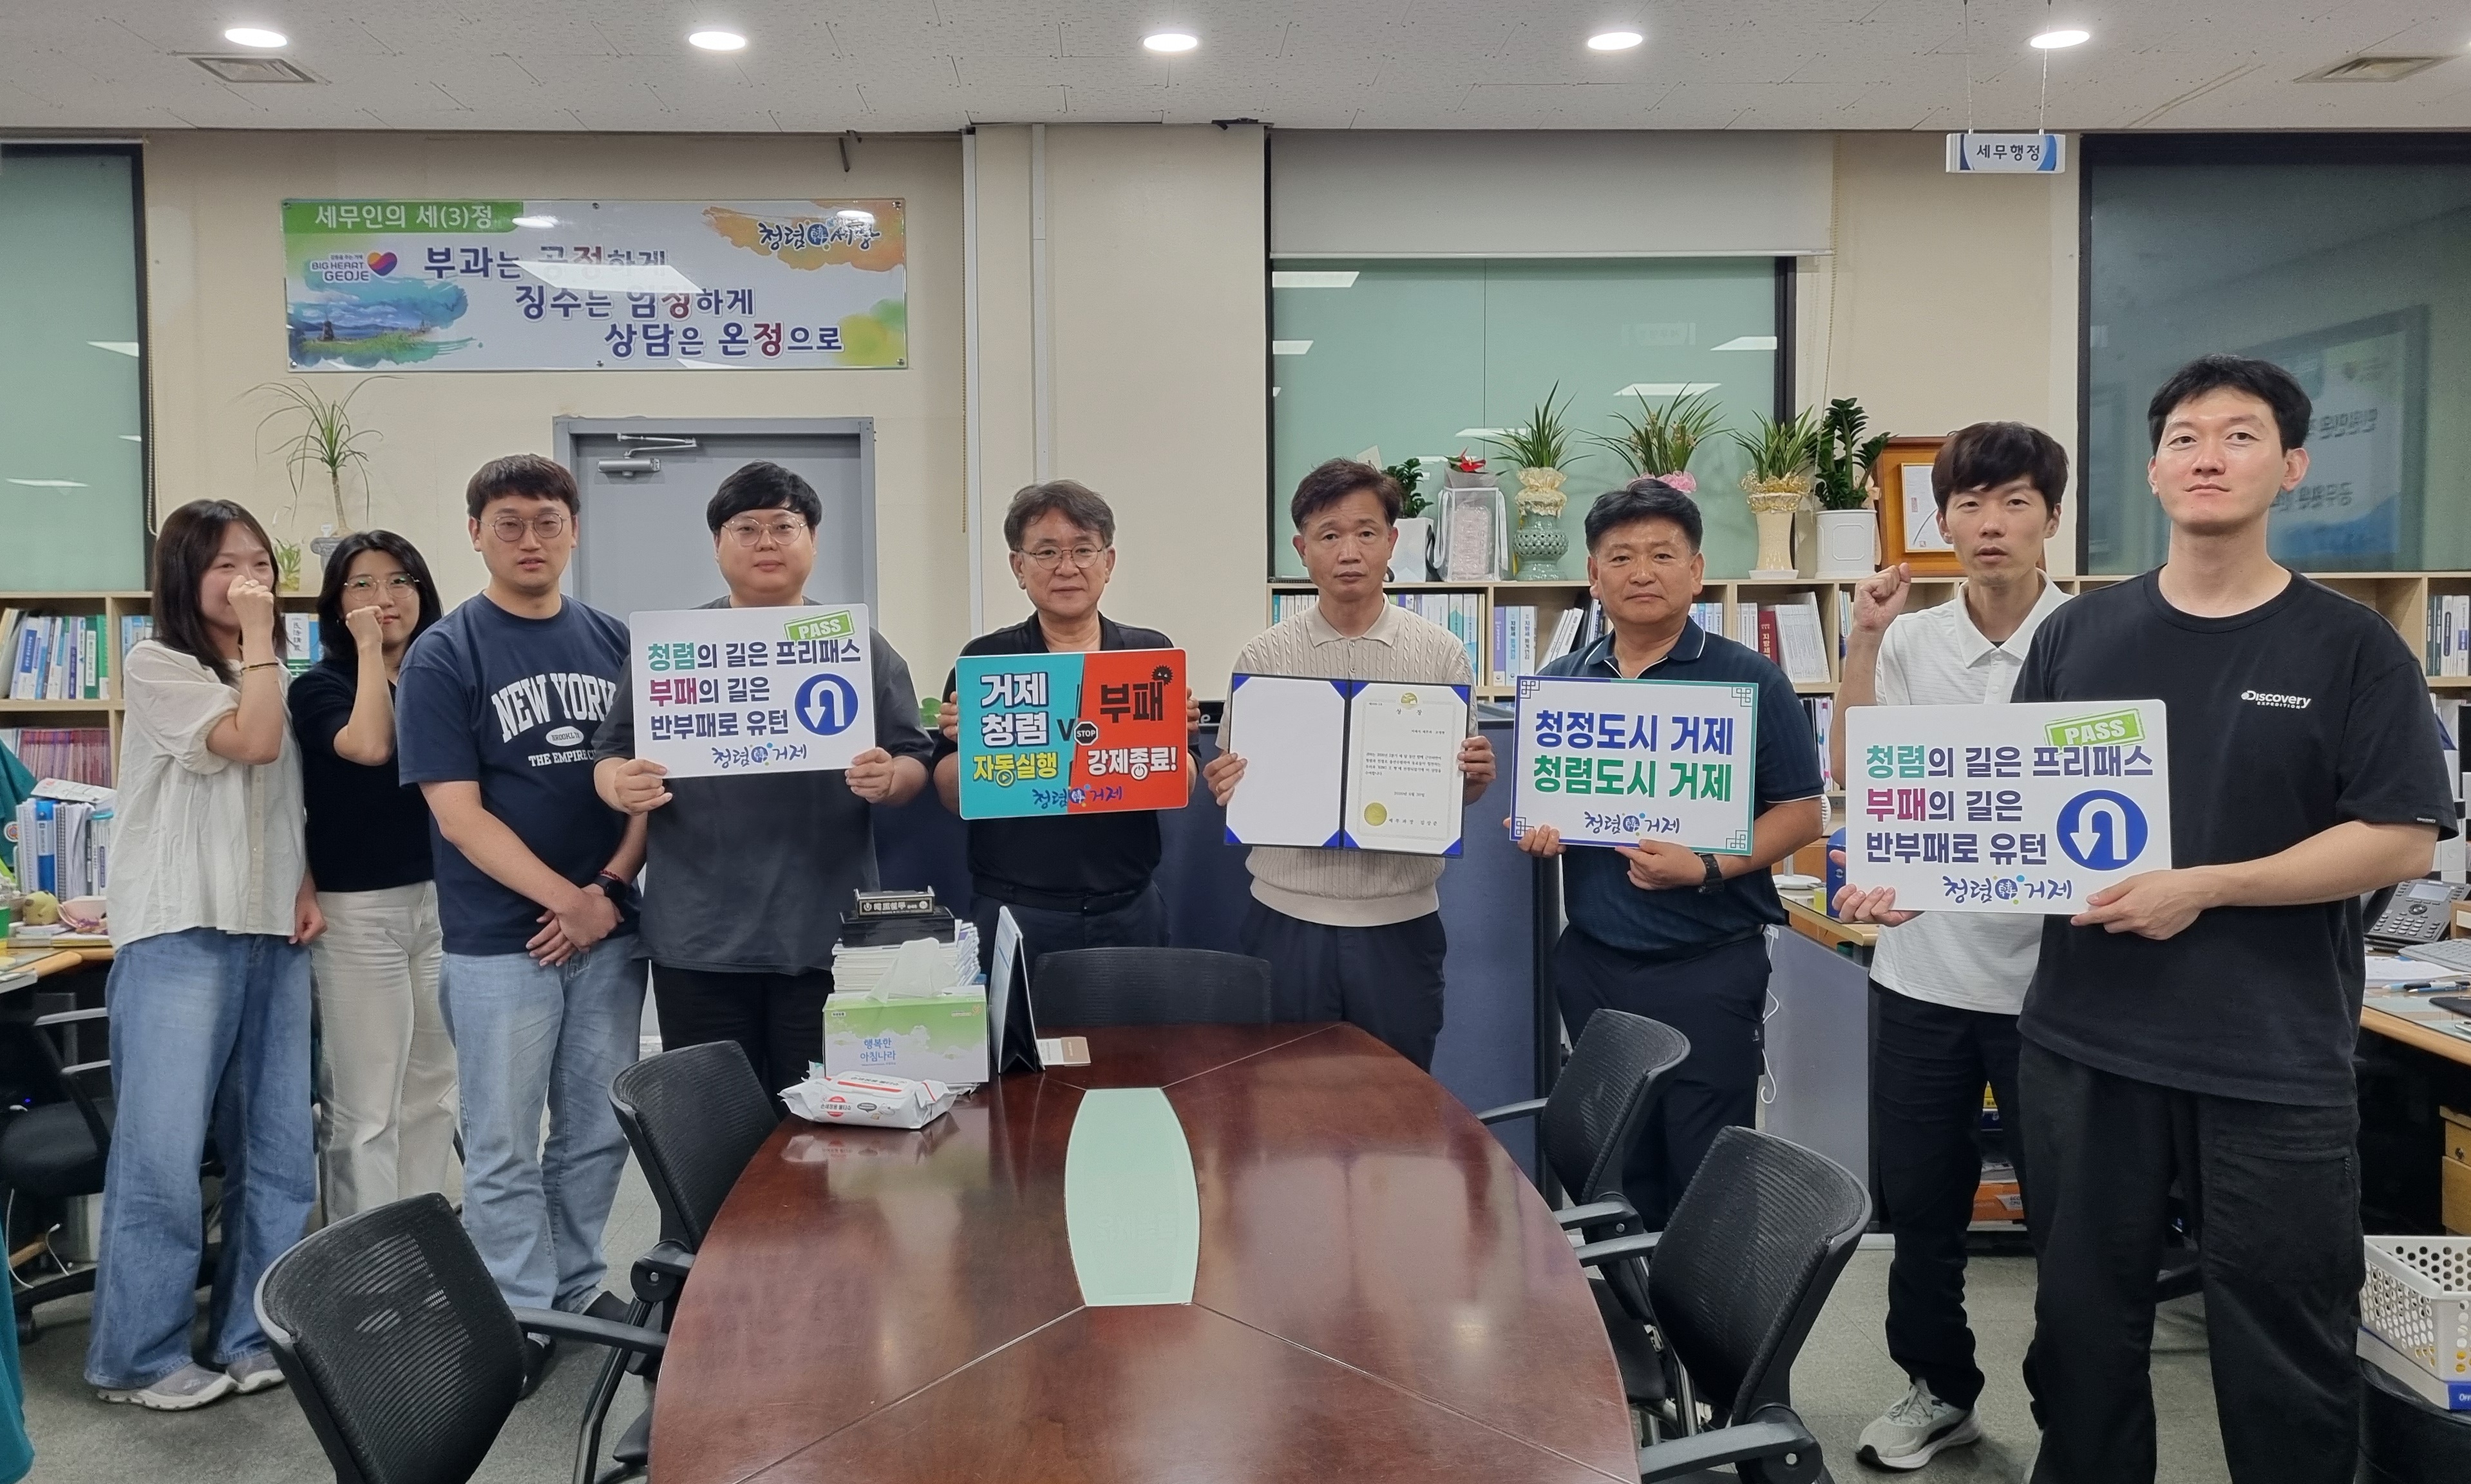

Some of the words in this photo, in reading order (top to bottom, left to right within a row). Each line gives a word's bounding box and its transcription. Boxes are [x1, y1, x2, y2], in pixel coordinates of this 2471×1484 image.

[1976, 144, 2040, 162] 세무행정
[315, 205, 406, 229] 세무인의
[416, 205, 492, 229] 세(3)정
[325, 270, 369, 281] GEOJE
[424, 247, 521, 279] 부과는
[515, 285, 612, 320] 징수는
[626, 285, 753, 319] 엄정하게
[604, 323, 704, 358] 상담은
[718, 322, 842, 357] 온정으로
[799, 619, 842, 639] PASS
[648, 643, 717, 672] 청렴의
[725, 642, 768, 668] 길은
[776, 639, 861, 665] 프리패스
[649, 677, 719, 706] 부패의
[727, 677, 770, 703] 길은
[981, 672, 1048, 708] 거제
[1100, 681, 1164, 724] 부패
[2241, 690, 2312, 709] Discovery
[2257, 701, 2300, 709] EXPEDITION
[491, 673, 551, 743] NEW
[650, 712, 739, 740] 반부패로
[746, 709, 789, 737] 유턴
[982, 711, 1048, 747] 청렴
[1076, 729, 1095, 738] STOP
[1535, 710, 1658, 752] 청정도시
[1671, 717, 1734, 755] 거제
[2065, 719, 2125, 745] PASS
[528, 752, 552, 767] THE
[552, 749, 587, 764] EMPIRE
[973, 752, 1057, 787] 자동실행
[1088, 746, 1177, 780] 강제종료!
[1866, 745, 1954, 778] 청렴의
[1965, 747, 2021, 777] 길은
[2033, 746, 2154, 776] 프리패스
[1533, 755, 1656, 798] 청렴도시
[1669, 762, 1732, 802] 거제
[1866, 789, 1955, 822] 부패의
[1966, 790, 2022, 822] 길은
[1867, 832, 1978, 864] 반부패로
[1989, 833, 2047, 865] 유턴
[2023, 879, 2072, 900] 거제
[860, 1050, 896, 1062] 아침나라
[864, 1037, 892, 1050] 행복한
